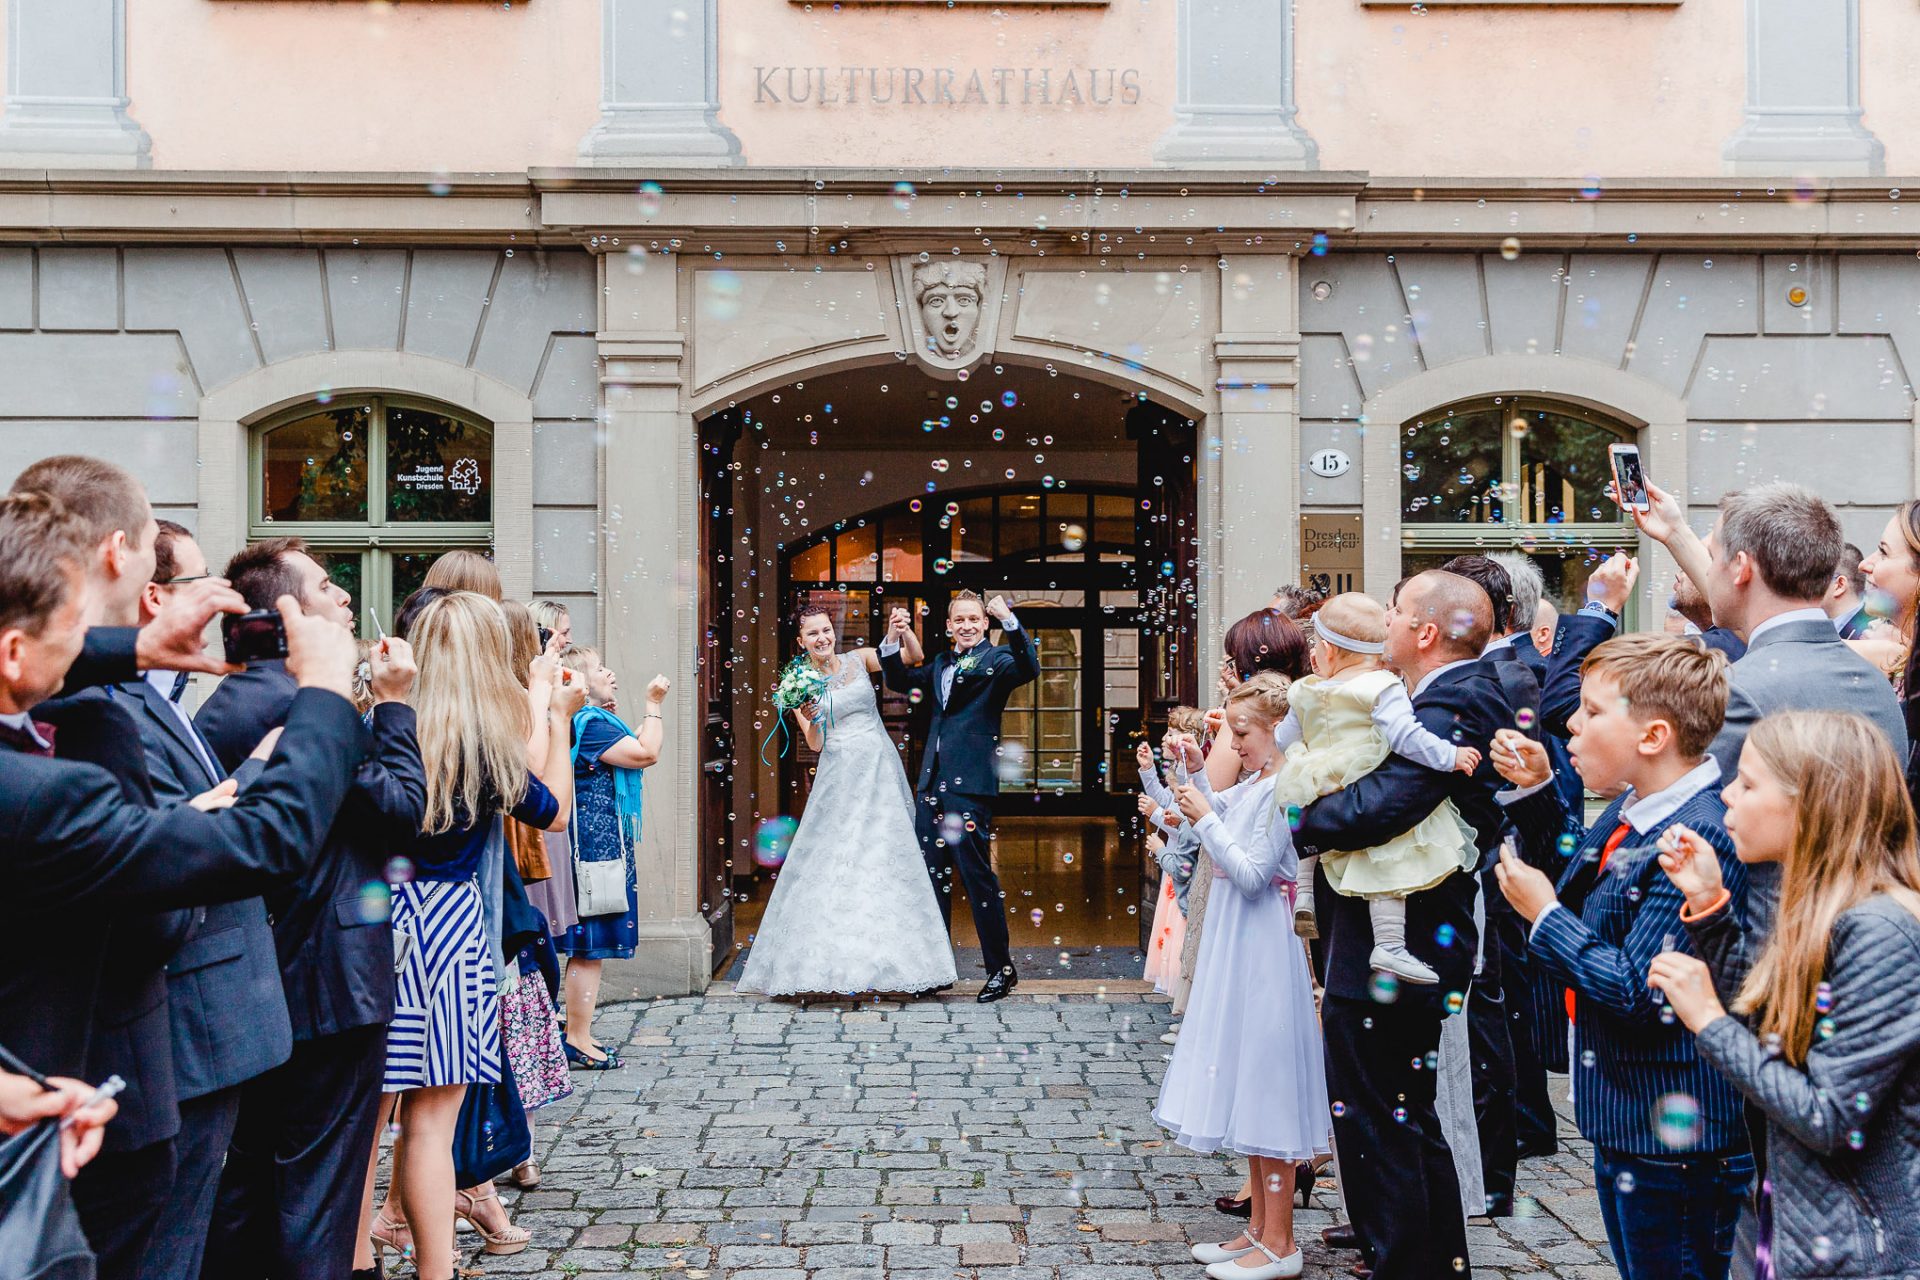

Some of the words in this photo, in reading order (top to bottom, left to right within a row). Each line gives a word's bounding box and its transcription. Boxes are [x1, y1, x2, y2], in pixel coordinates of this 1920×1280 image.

[753, 66, 1142, 105] KULTURRATHAUS
[1322, 454, 1339, 471] 15
[415, 465, 444, 474] Jugend
[397, 474, 444, 482] Kunstschule
